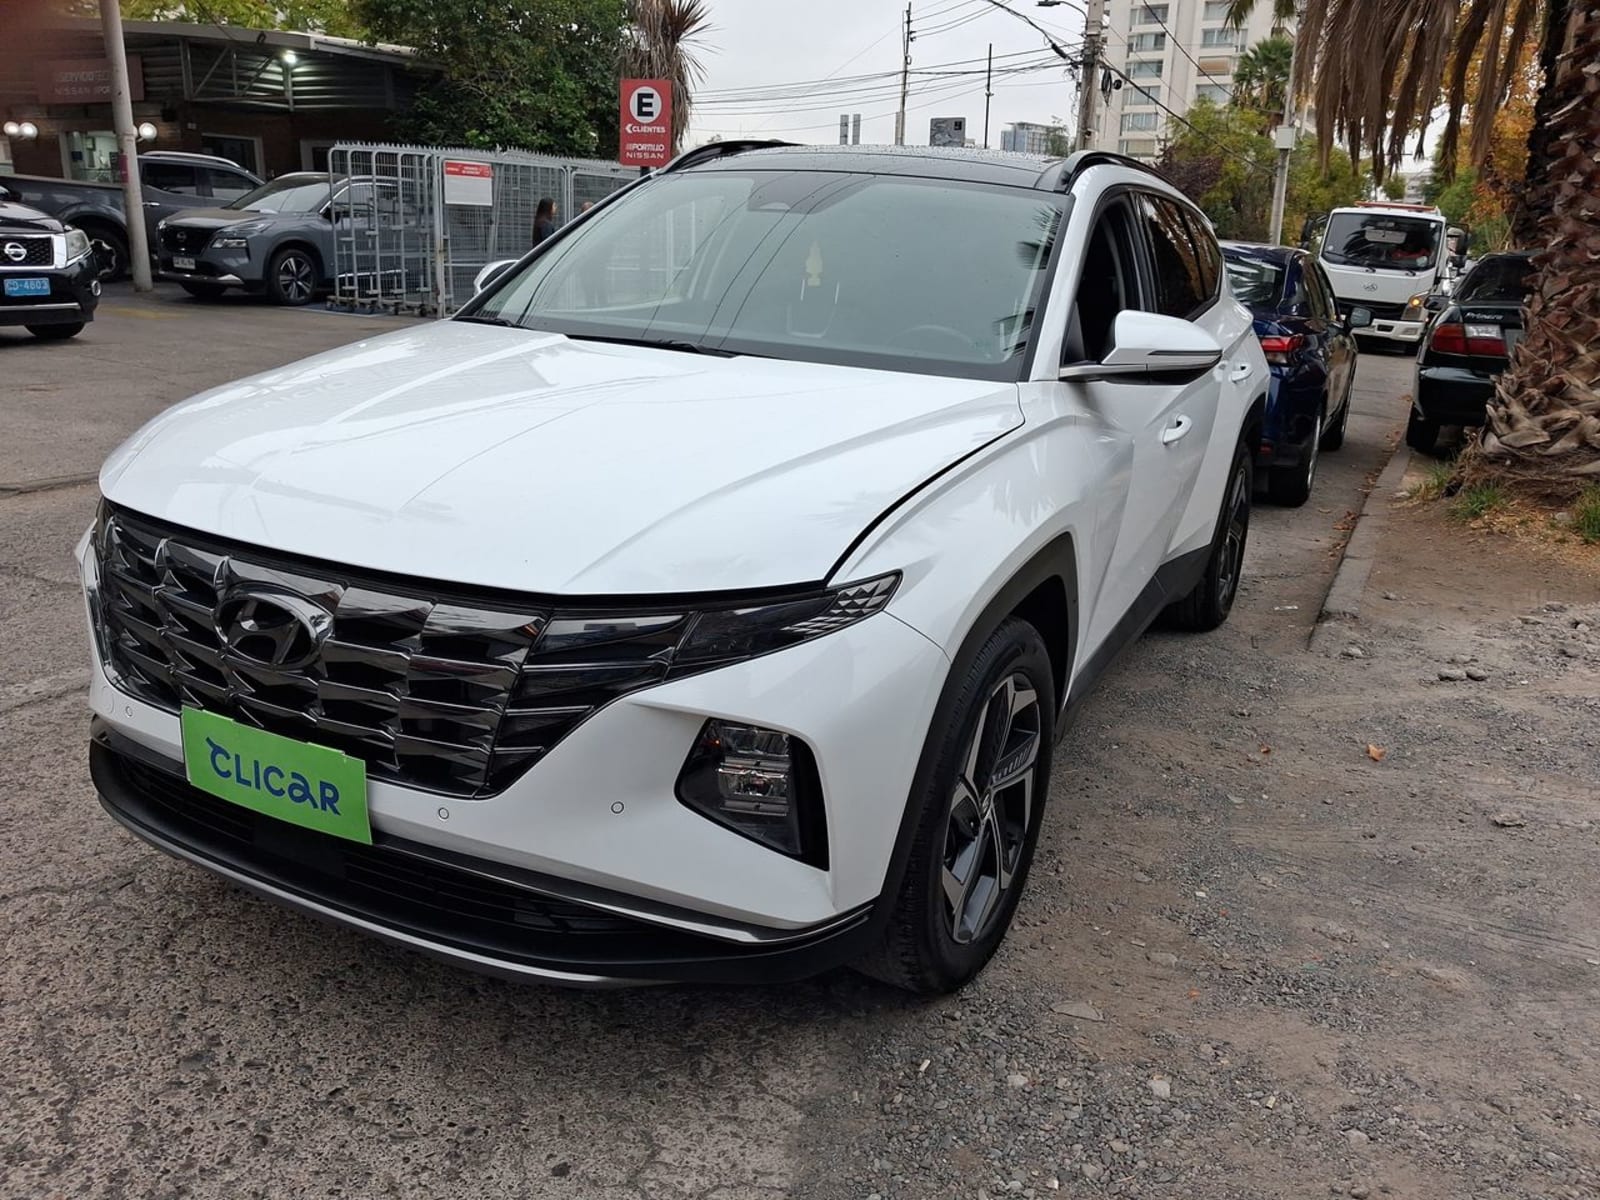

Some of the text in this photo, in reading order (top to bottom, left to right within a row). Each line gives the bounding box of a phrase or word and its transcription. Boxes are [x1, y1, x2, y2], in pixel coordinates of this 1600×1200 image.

[637, 93, 654, 117] E
[631, 125, 666, 134] CLIENTES
[625, 152, 665, 160] NISSAN
